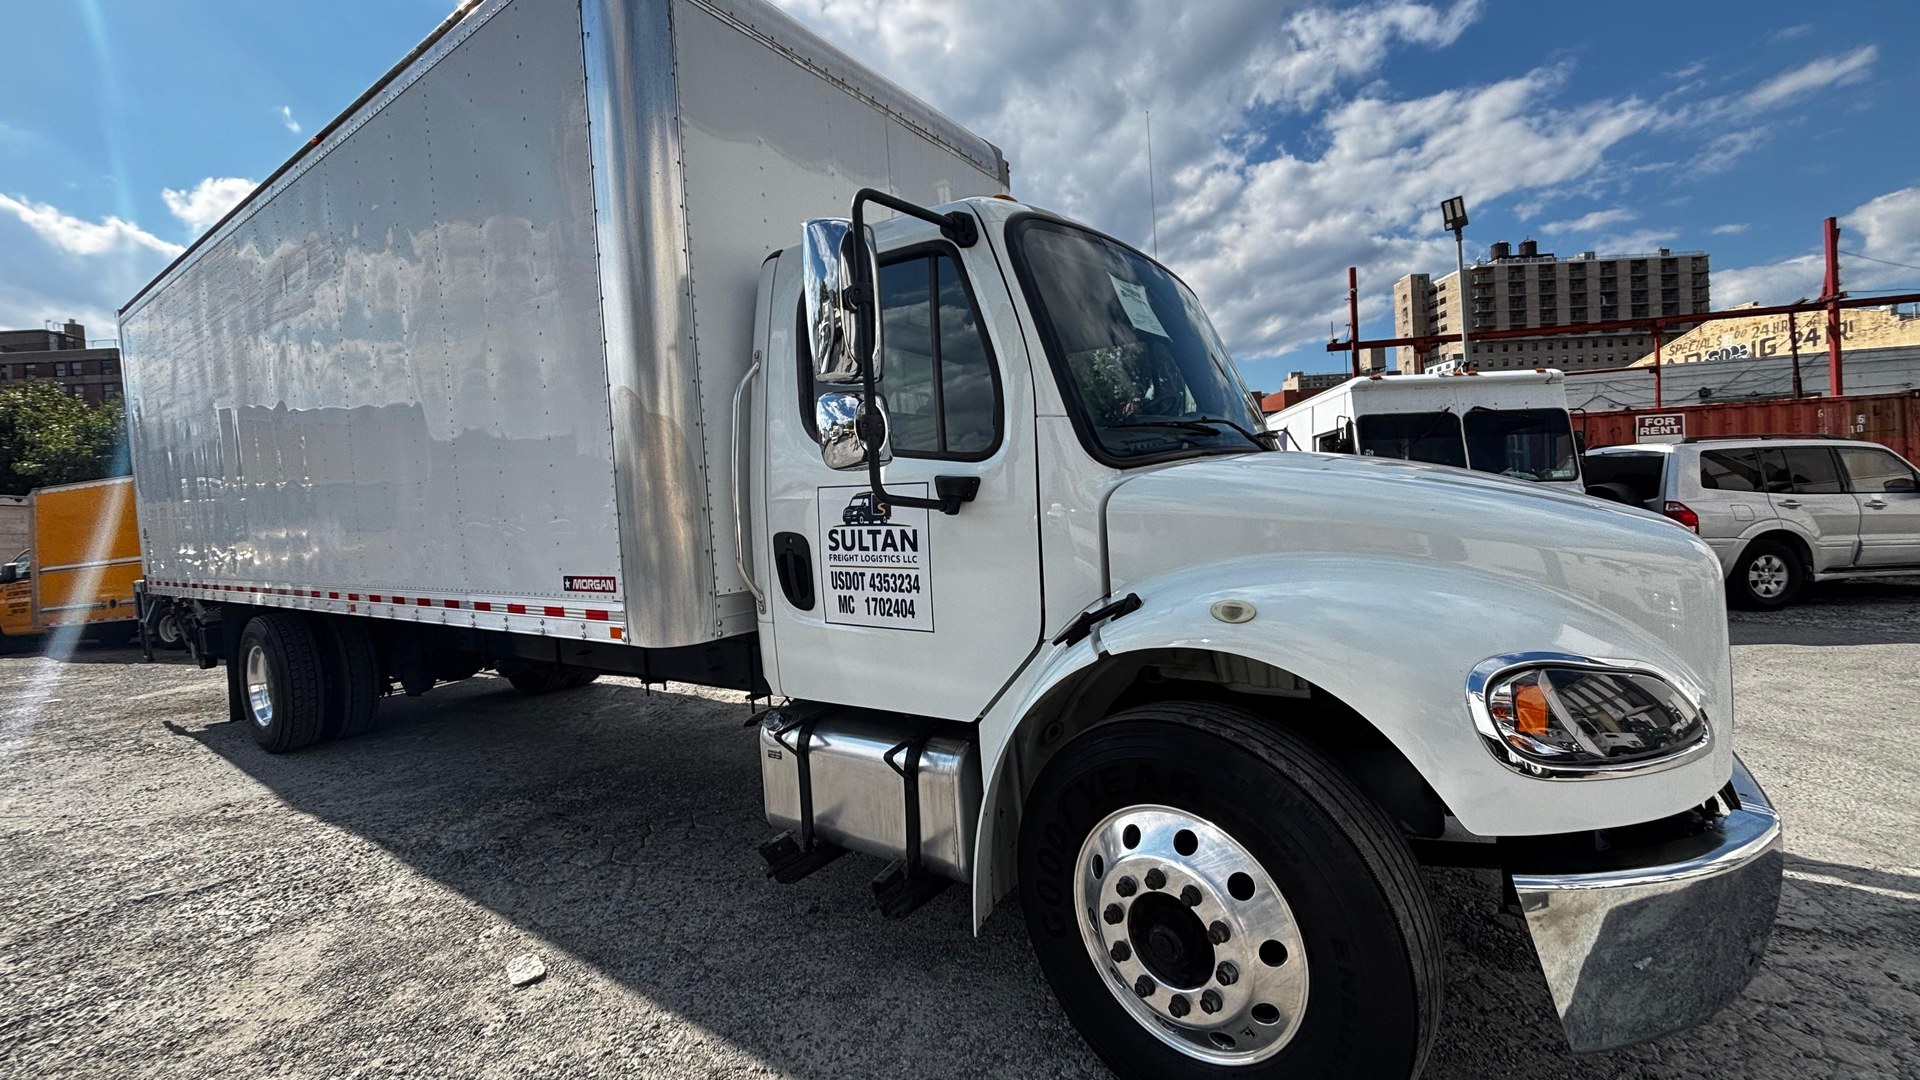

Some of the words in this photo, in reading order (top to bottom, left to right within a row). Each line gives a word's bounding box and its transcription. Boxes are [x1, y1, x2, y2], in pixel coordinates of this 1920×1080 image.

[1668, 337, 1713, 356] SPECIAL
[1752, 324, 1769, 339] 24
[1640, 425, 1681, 436] RENT
[1644, 417, 1676, 427] FOR
[828, 529, 918, 552] SULTAN
[828, 553, 859, 563] FREIGHT
[860, 554, 901, 564] LOGISTICS
[903, 555, 918, 564] LLC
[572, 578, 615, 591] MORGAN
[830, 570, 866, 592] USDOT
[869, 572, 920, 594] 4353234
[838, 594, 855, 615] MC
[864, 596, 916, 619] 1702404
